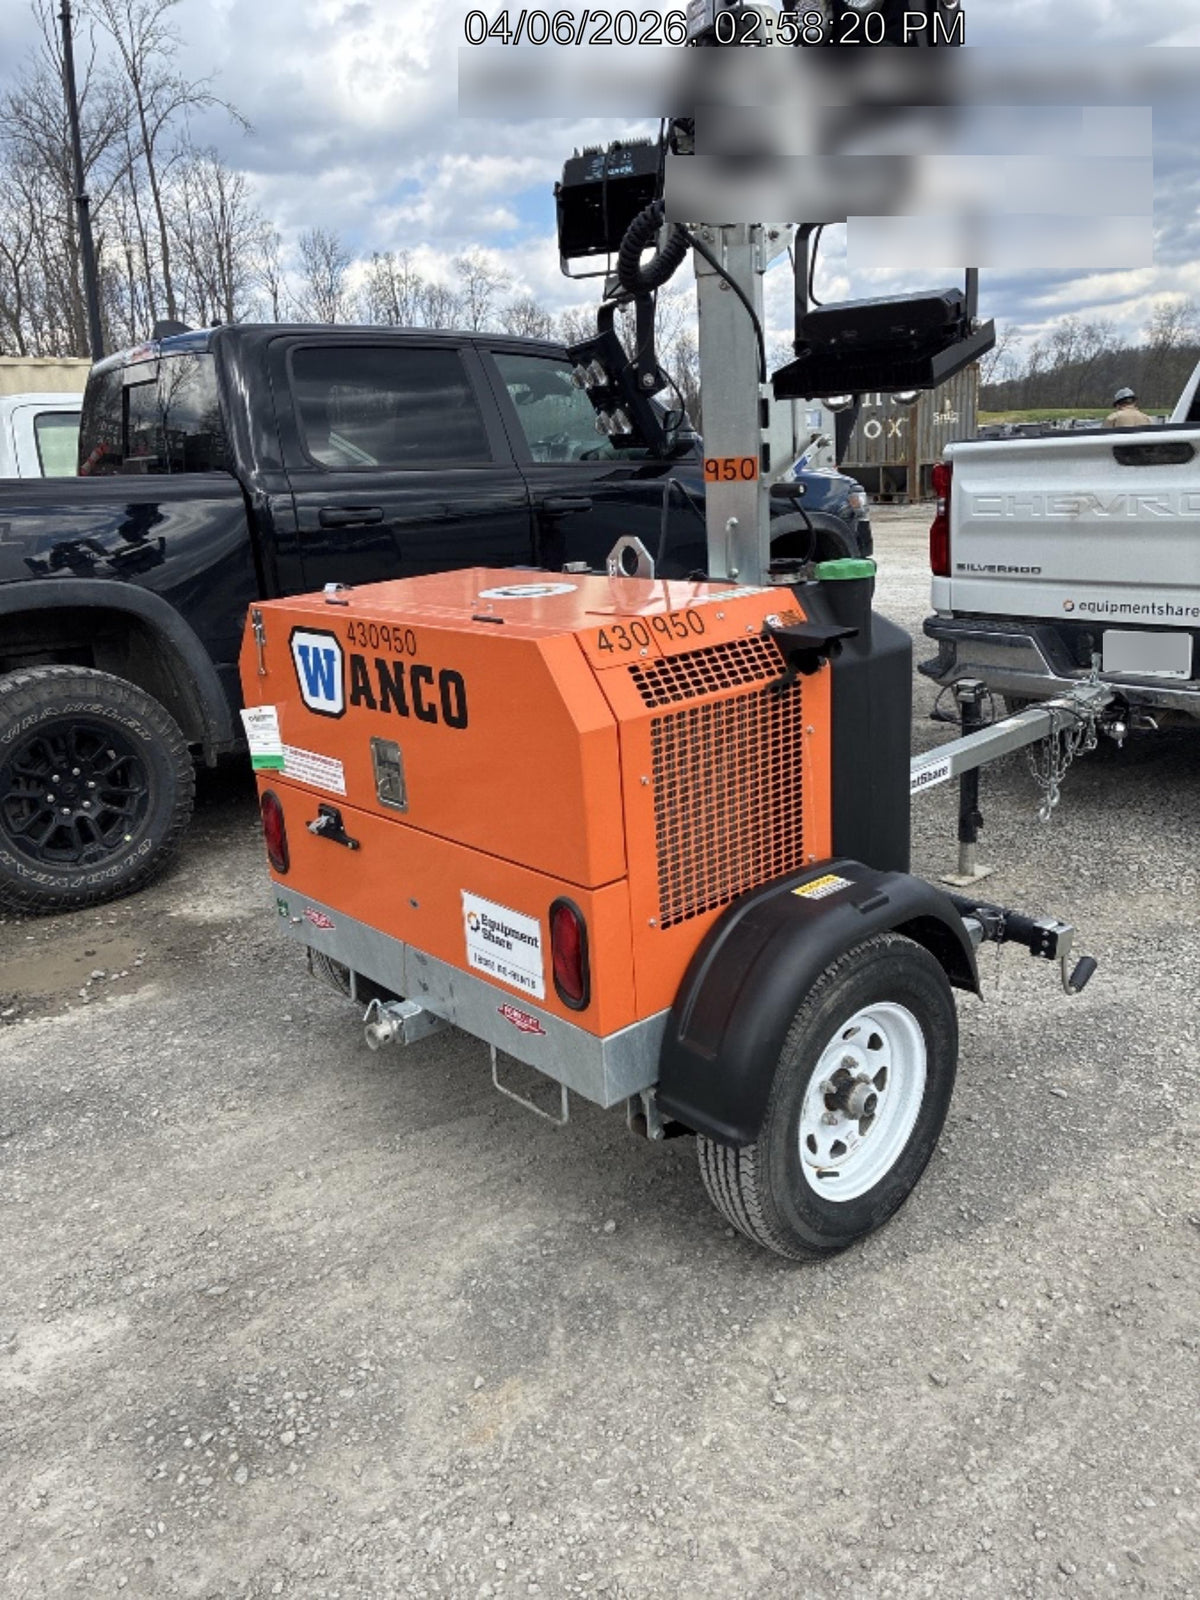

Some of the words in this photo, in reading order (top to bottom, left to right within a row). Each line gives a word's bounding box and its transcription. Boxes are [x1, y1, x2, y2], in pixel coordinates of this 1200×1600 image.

[705, 458, 754, 481] 950
[955, 563, 1042, 575] SILVERADO
[1078, 600, 1200, 618] equipmentshare
[347, 621, 417, 656] 430950
[597, 608, 706, 653] 430950
[296, 643, 468, 730] WANCO
[481, 913, 540, 949] Equipment
[482, 928, 513, 951] Share
